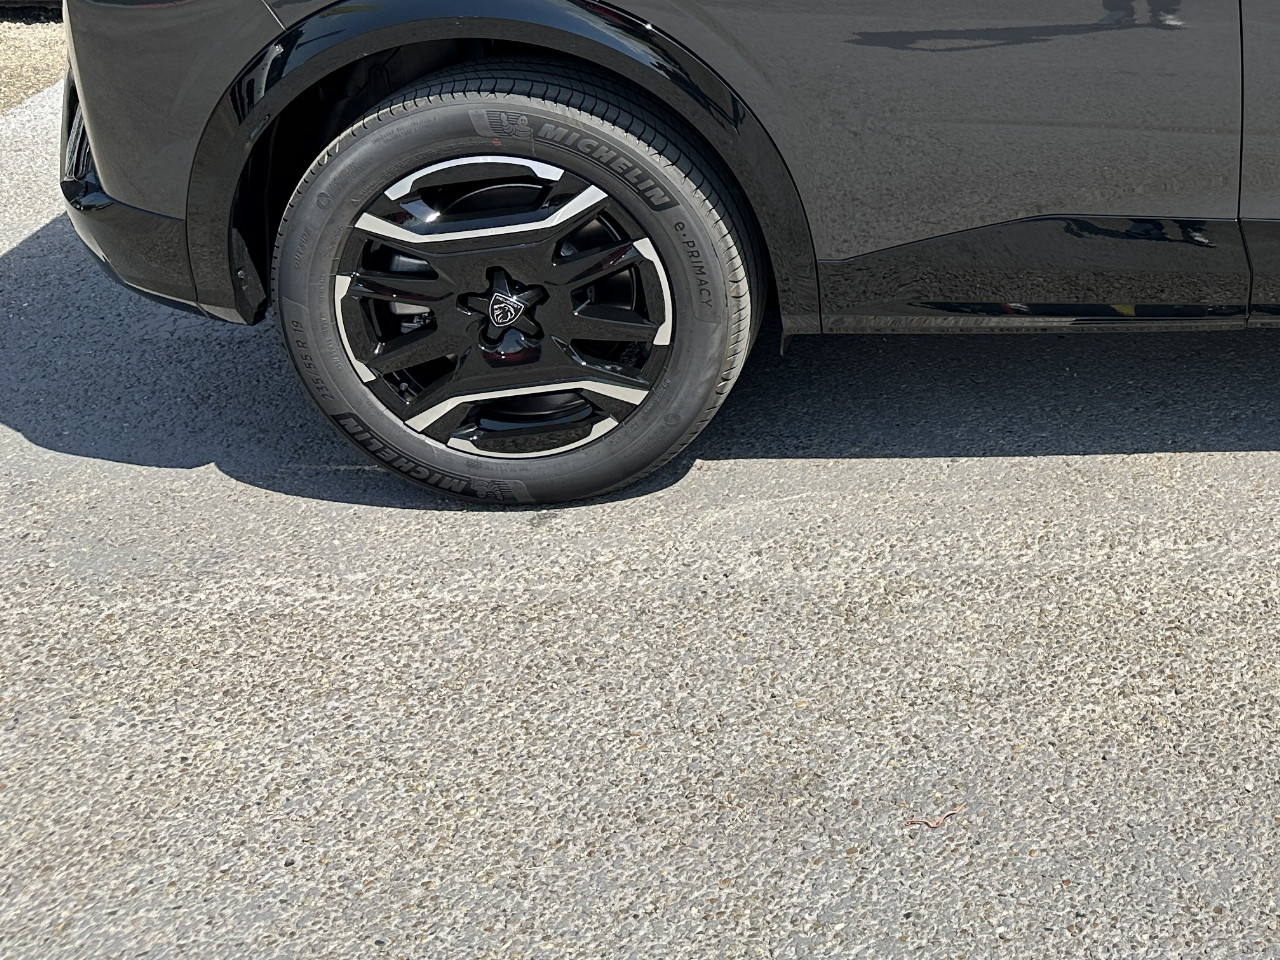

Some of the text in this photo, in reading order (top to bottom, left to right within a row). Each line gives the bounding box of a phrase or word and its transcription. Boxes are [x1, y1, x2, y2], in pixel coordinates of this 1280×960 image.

[537, 122, 672, 207] MICHELIN
[290, 319, 304, 334] 19
[296, 339, 309, 350] R
[299, 353, 335, 400] 235/55
[338, 417, 468, 494] MICHELIN
